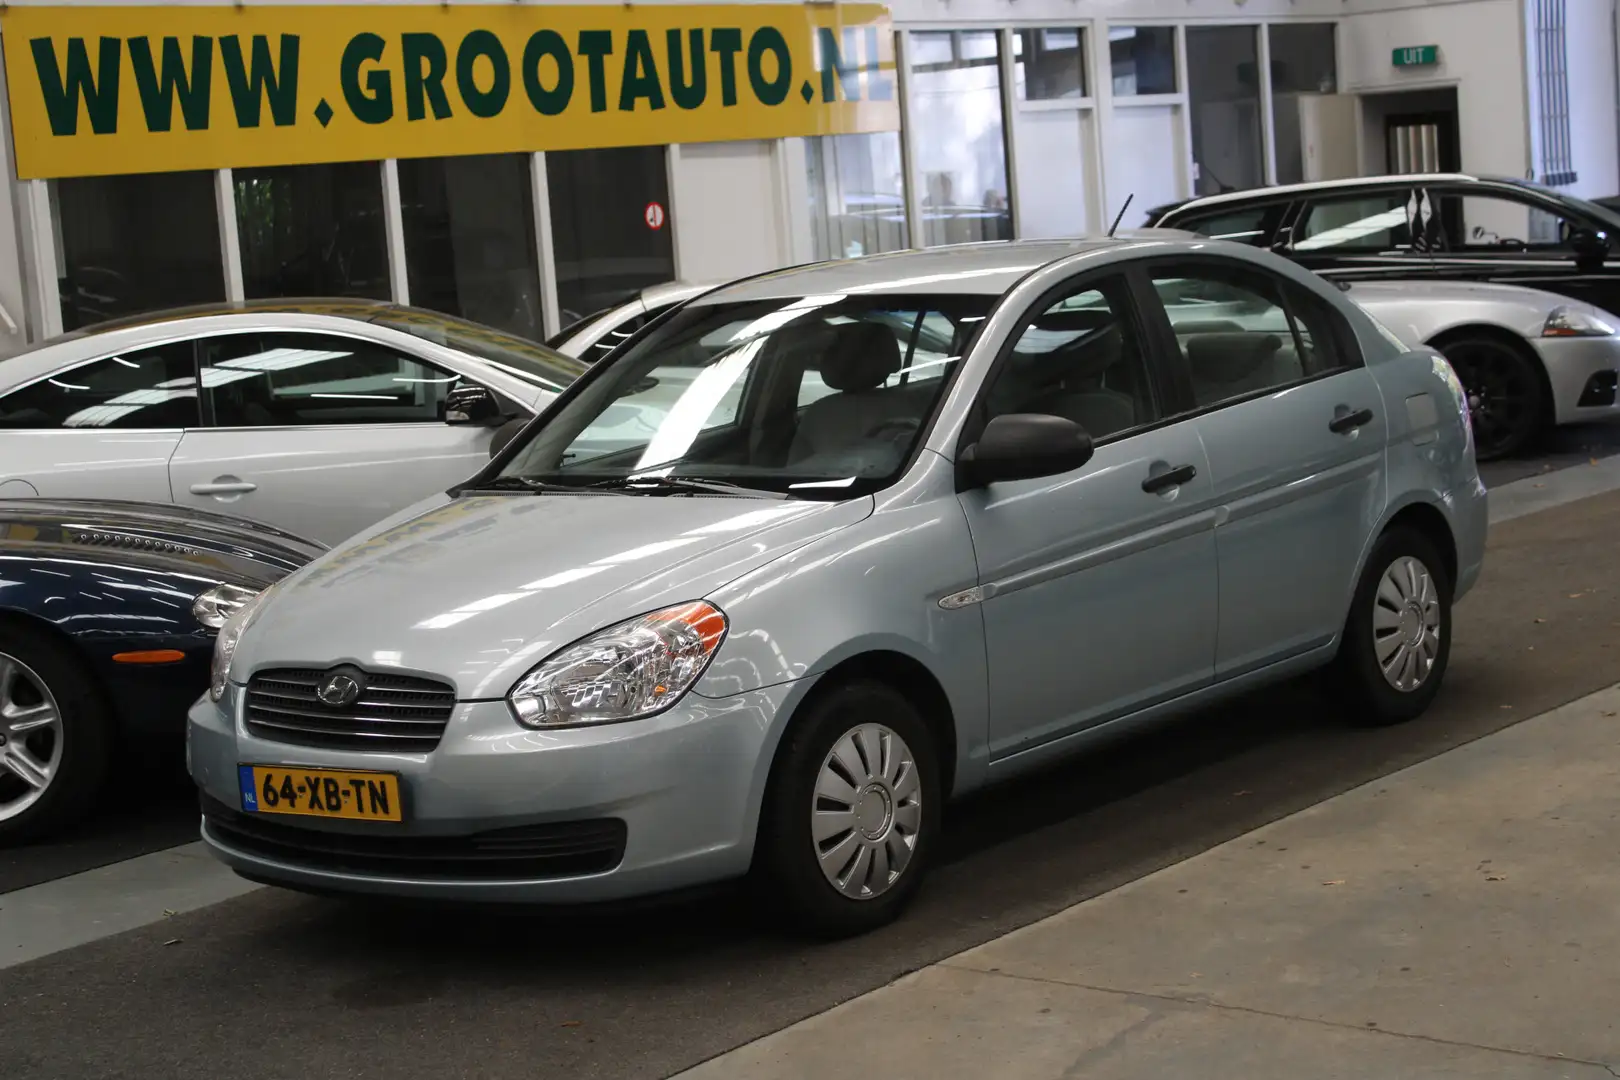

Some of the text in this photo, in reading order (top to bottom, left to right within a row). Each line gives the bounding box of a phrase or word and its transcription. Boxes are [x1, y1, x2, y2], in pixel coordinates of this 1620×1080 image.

[1403, 47, 1425, 64] UIT
[244, 792, 256, 803] NL
[262, 774, 389, 815] 64-XB-TN
